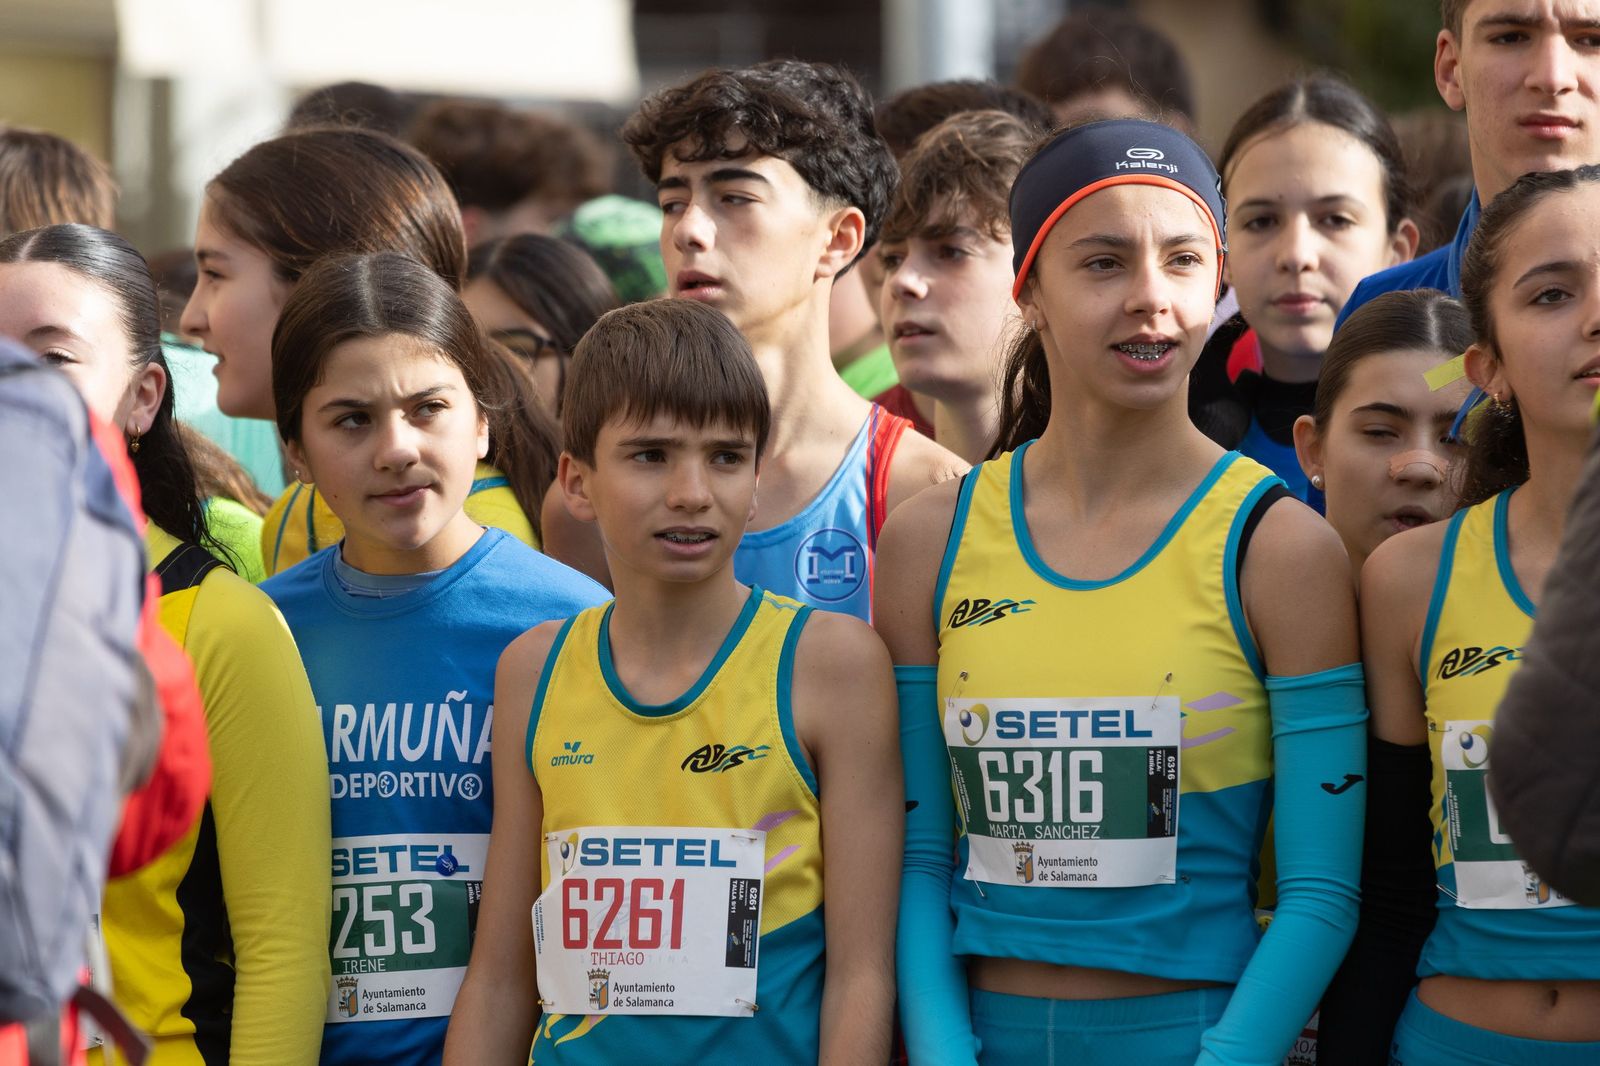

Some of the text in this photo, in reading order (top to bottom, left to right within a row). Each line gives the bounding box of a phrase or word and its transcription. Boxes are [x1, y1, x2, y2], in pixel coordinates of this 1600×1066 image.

[1115, 160, 1178, 173] Kalenji
[316, 690, 494, 764] RMUÑA
[995, 710, 1152, 739] SETEL
[551, 754, 594, 767] amura
[1167, 756, 1176, 780] 6316
[330, 771, 483, 800] DEPORTIVO
[978, 751, 1103, 823] 6316
[989, 823, 1100, 839] MARTA SANCHEZ
[580, 838, 736, 868] SETEL
[332, 845, 469, 877] SETEL
[1037, 856, 1098, 868] Ayuntamiento
[1038, 871, 1098, 882] de Salamanca
[749, 887, 758, 911] 6261
[562, 878, 685, 949] 6261
[343, 959, 386, 974] IRENE
[591, 952, 645, 966] THIAGO
[362, 987, 426, 1001] Ayuntamiento
[613, 982, 675, 994] Ayuntamiento
[363, 1002, 427, 1014] de Salamanca
[613, 997, 674, 1007] de Salamanca
